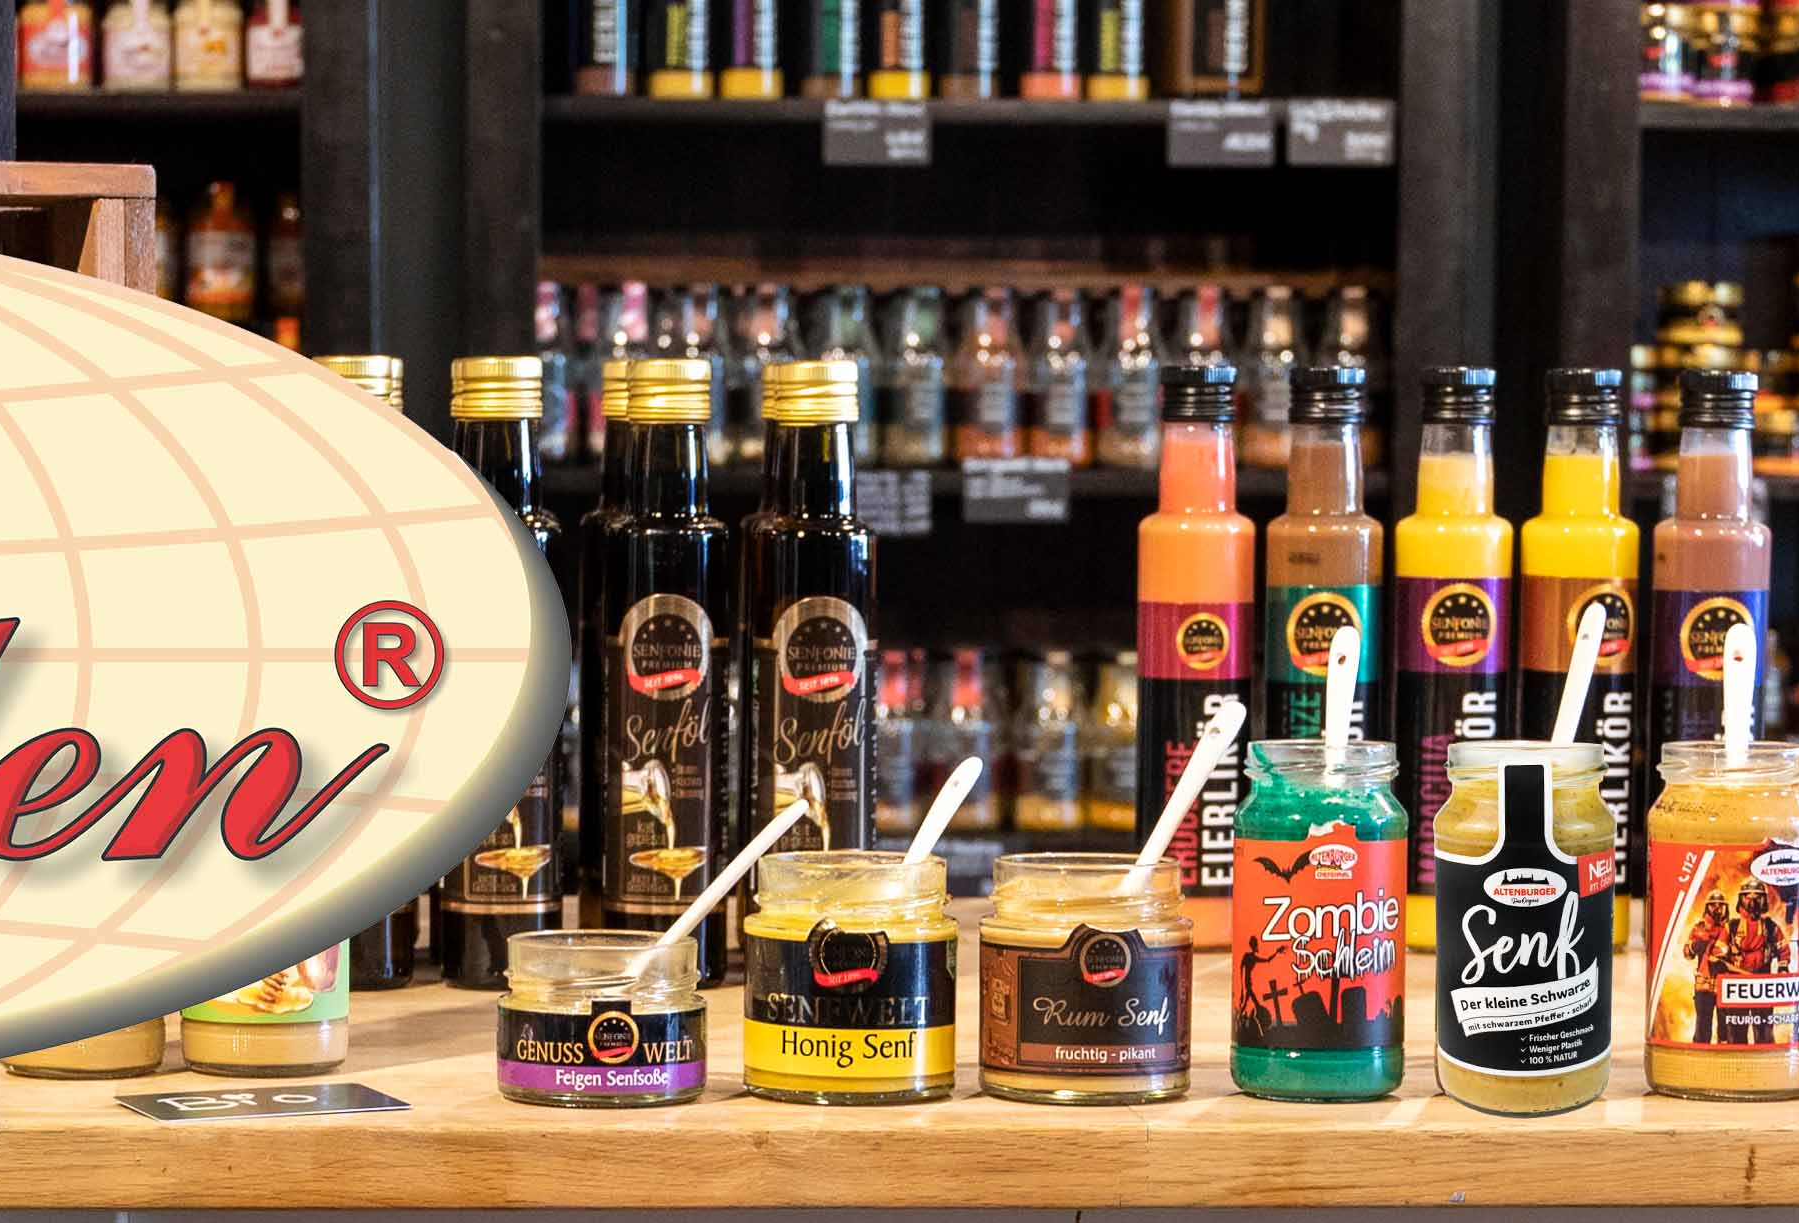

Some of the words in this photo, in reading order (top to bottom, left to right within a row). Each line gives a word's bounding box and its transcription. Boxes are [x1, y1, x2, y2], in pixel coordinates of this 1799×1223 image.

[626, 696, 711, 763] Senföl
[774, 698, 867, 765] Senföl
[1589, 855, 1612, 881] NEU
[1493, 887, 1557, 897] ALTENBURGER
[1261, 888, 1400, 942] Zombie
[1461, 890, 1585, 985] Senf
[1291, 928, 1396, 982] Schleim
[1460, 999, 1482, 1011] Der
[1485, 997, 1527, 1010] kleine
[1531, 977, 1591, 1006] Schwarze
[1033, 997, 1112, 1028] Rum
[1118, 996, 1170, 1036] Senf
[1468, 1022, 1481, 1031] mit
[1482, 1018, 1533, 1030] schwarzem
[1535, 1011, 1565, 1025] Pfeffer
[1725, 1015, 1762, 1026] FEURIG
[782, 1030, 854, 1069] Honig
[863, 1031, 917, 1059] Senf
[1529, 1033, 1558, 1043] Frischer
[1529, 1044, 1560, 1054] Weniger
[1561, 1039, 1583, 1050] Plastik
[517, 1039, 585, 1065] GENUSS
[644, 1039, 693, 1064] WELT
[1055, 1046, 1108, 1063] fruchtig
[1119, 1046, 1157, 1062] pikant
[1529, 1056, 1544, 1065] 100
[1554, 1051, 1578, 1063] NATUR
[555, 1068, 602, 1091] Feigen
[606, 1067, 669, 1087] Senfsoße
